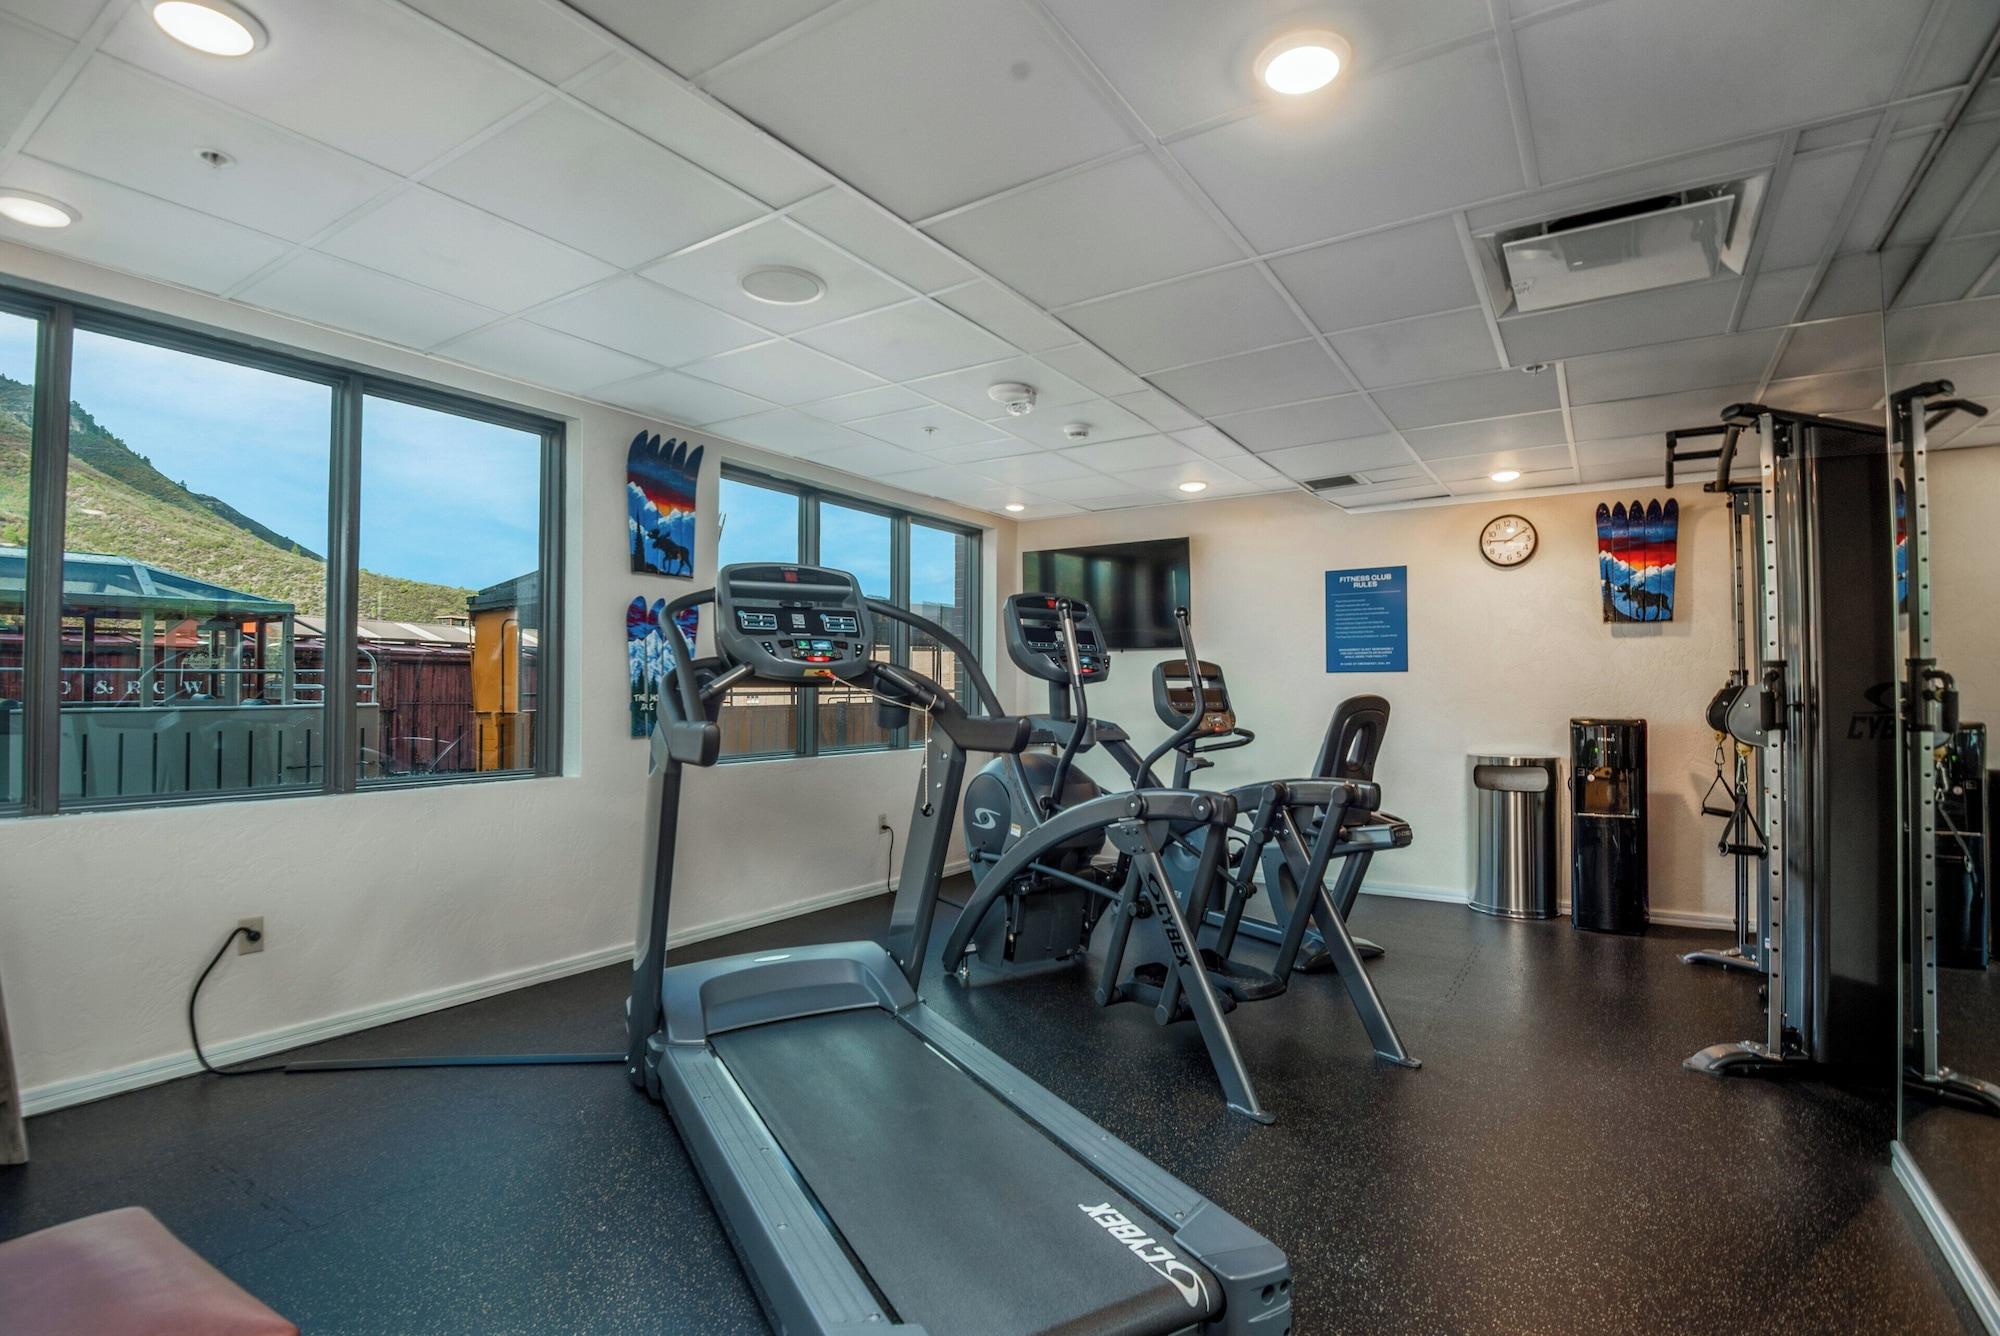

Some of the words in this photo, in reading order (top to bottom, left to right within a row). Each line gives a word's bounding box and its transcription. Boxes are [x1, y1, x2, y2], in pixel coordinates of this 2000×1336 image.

[1339, 575, 1370, 583] FITNESS
[1371, 573, 1392, 581] CLUB
[1156, 903, 1191, 967] CYBEX
[1077, 1202, 1176, 1263] CYBEX
